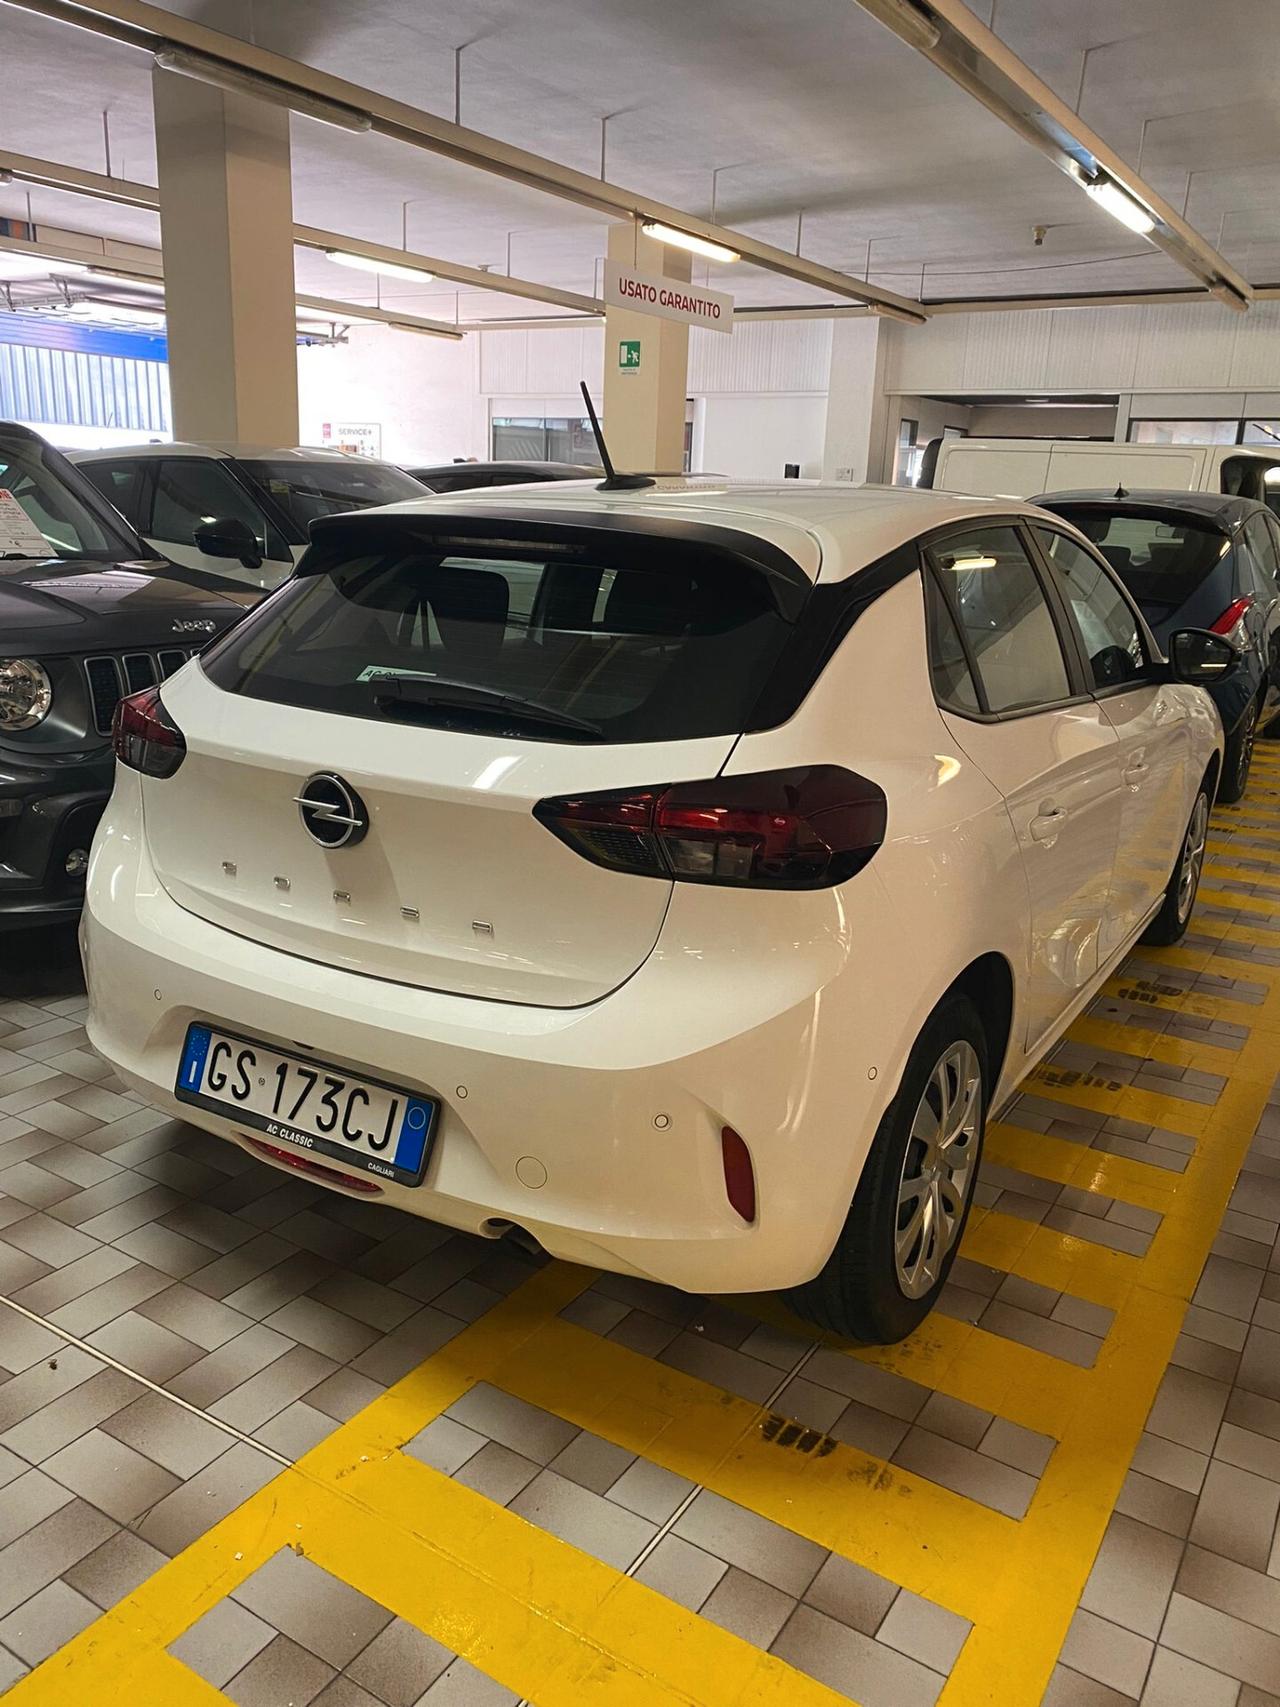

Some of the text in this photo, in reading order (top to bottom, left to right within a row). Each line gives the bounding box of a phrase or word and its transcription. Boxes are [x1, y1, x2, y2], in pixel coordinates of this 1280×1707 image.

[619, 278, 721, 318] USATO GARANTITO
[172, 619, 216, 633] Jeep
[189, 1041, 399, 1151] I GS 173CJ
[266, 1123, 314, 1148] AC CLASSIC
[367, 1162, 395, 1178] CAGLIARI
